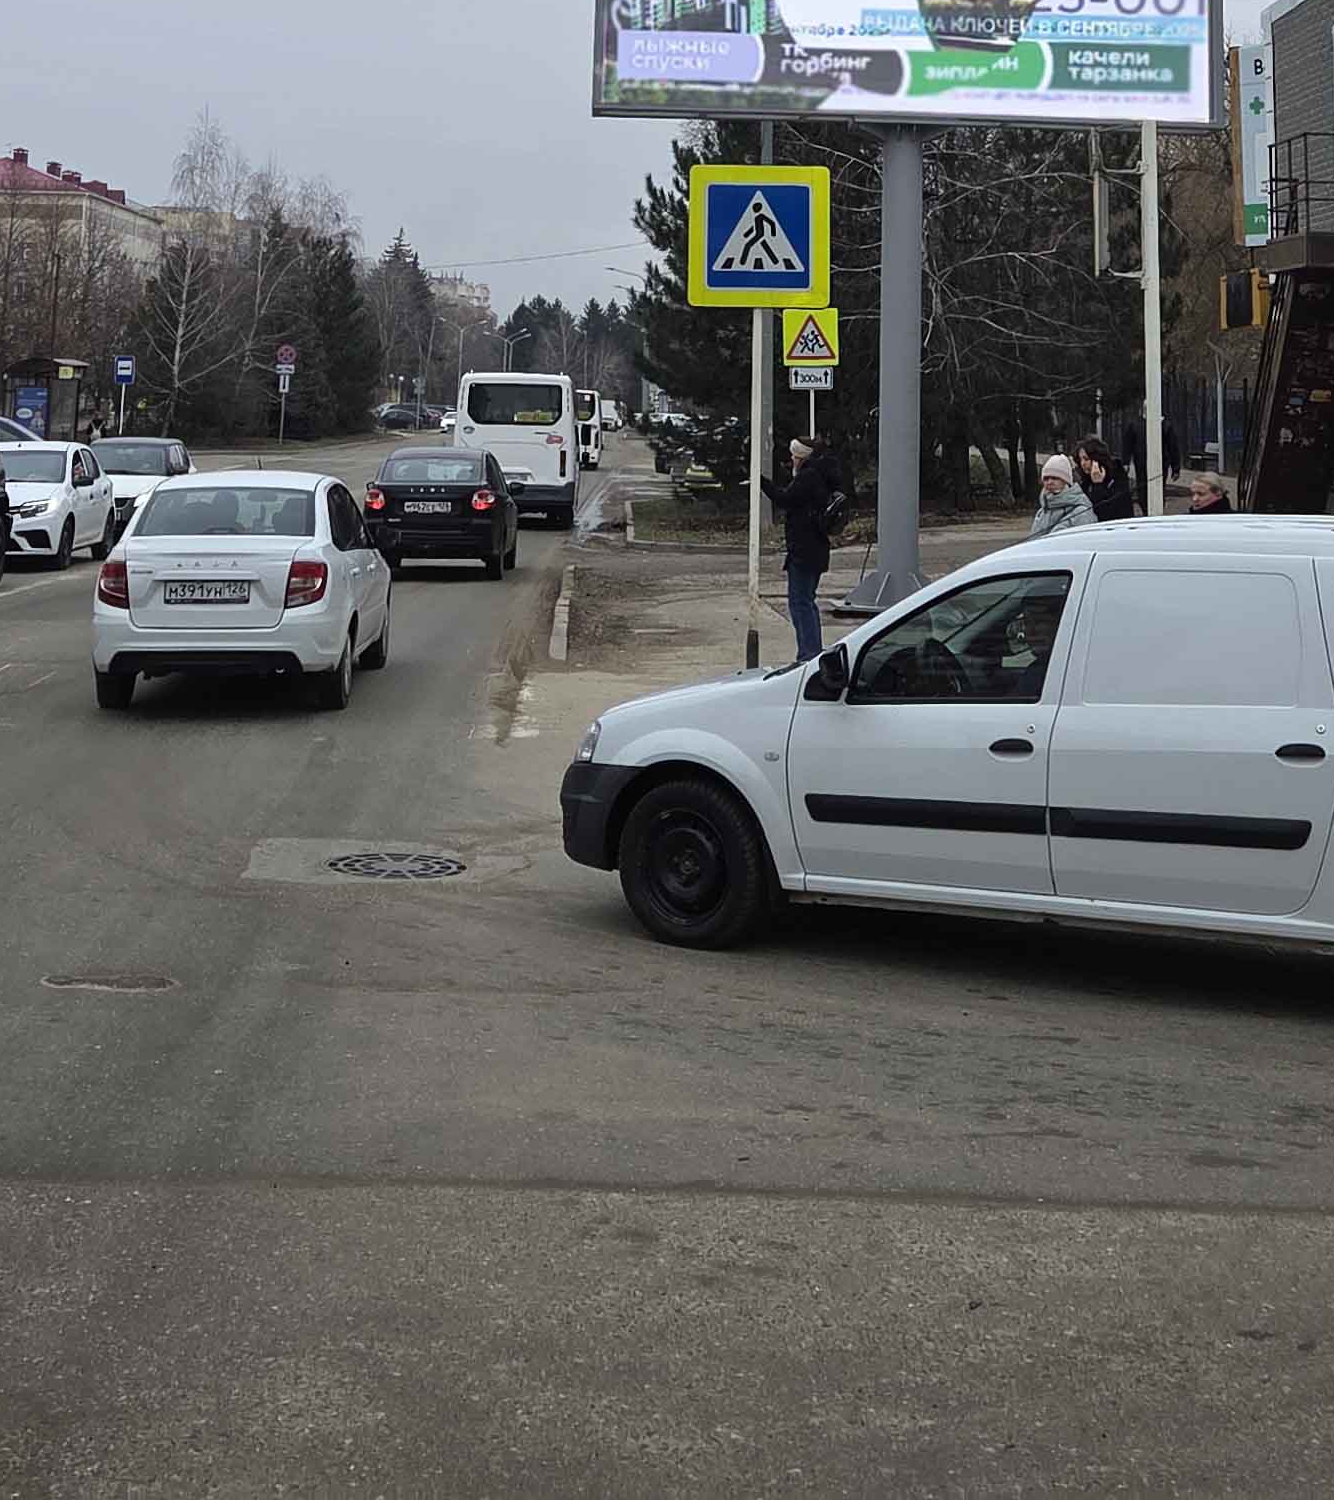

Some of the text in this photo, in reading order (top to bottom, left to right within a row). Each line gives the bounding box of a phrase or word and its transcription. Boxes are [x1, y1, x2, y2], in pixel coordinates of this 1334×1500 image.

[631, 54, 710, 71] спуски
[1068, 49, 1151, 66] качели
[1068, 66, 1174, 83] тарзанка
[168, 582, 247, 599] М391УН 126
